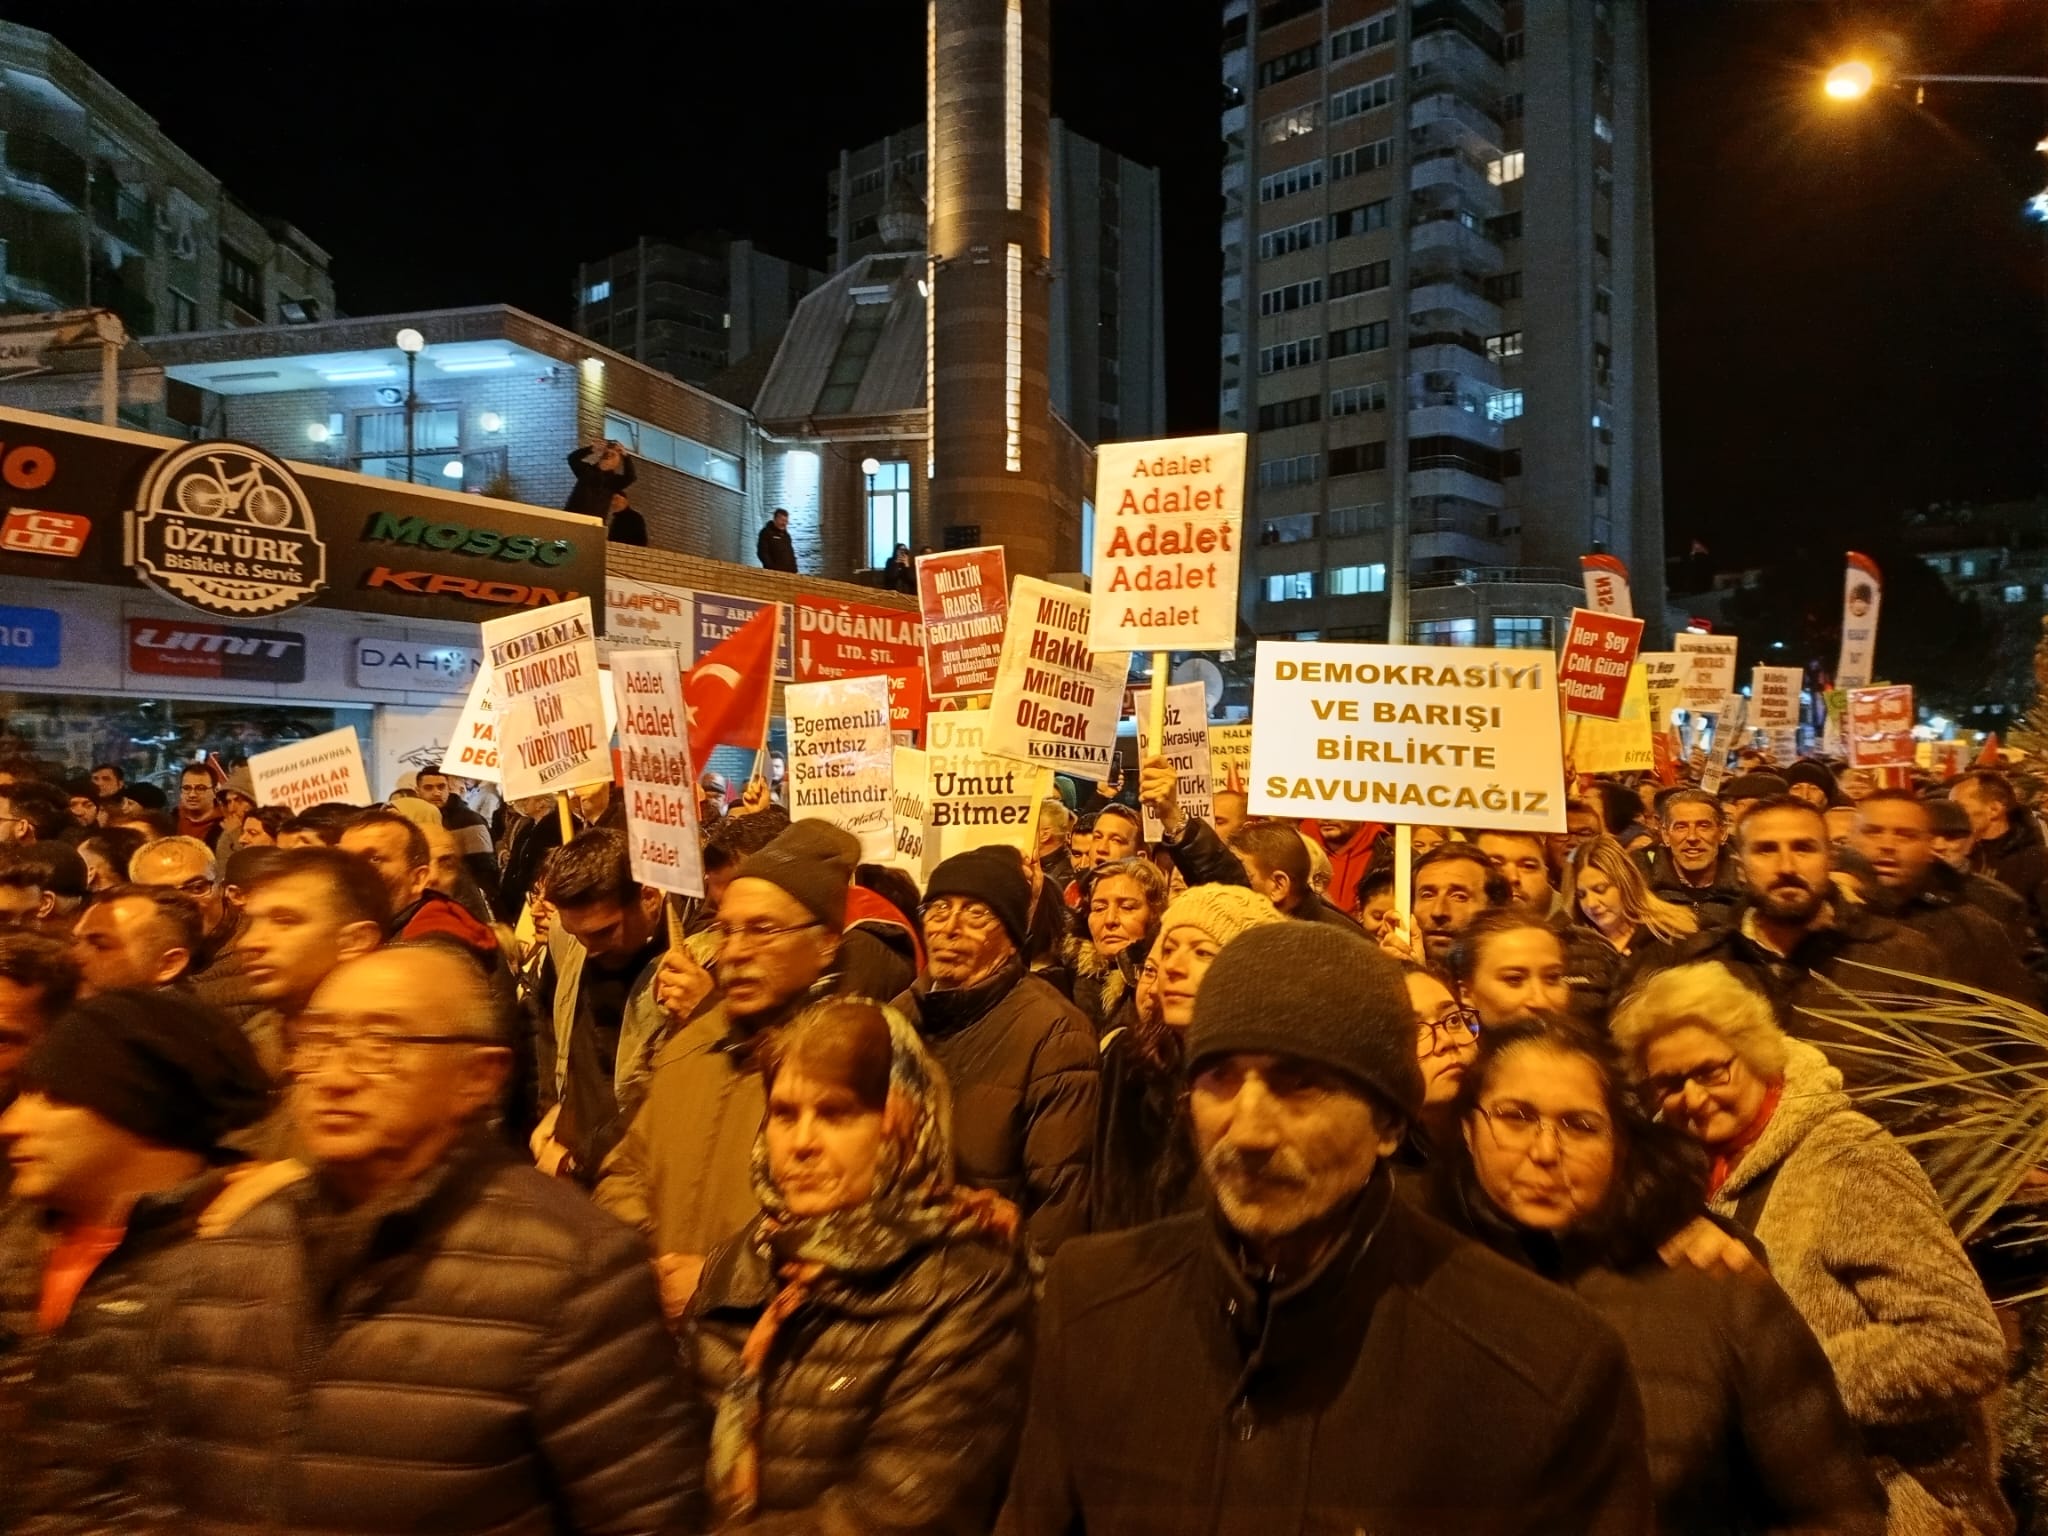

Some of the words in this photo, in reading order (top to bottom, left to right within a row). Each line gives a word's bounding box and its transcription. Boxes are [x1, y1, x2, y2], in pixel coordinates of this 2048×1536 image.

[1132, 455, 1212, 478] Adalet
[1117, 483, 1224, 516] Adalet
[164, 518, 303, 566] ÖZTÜRK
[368, 511, 578, 568] MOSSO
[1106, 519, 1233, 558] Adalet
[164, 553, 232, 575] Bisiklet
[233, 561, 250, 577] &
[251, 563, 303, 583] Servis
[934, 562, 983, 595] MİLLETİN
[1108, 562, 1217, 593] Adalet
[607, 590, 682, 616] UAFÖR
[941, 588, 983, 620] İRADESİ
[1036, 596, 1091, 636] Milleti
[1120, 606, 1200, 628] Adalet
[799, 603, 924, 648] DOĞANLAR
[929, 614, 1004, 646] GÖZALTINDA!
[1572, 626, 1599, 647] Her
[1604, 631, 1629, 653] Şey
[491, 618, 586, 668] KORKMA
[837, 643, 867, 661] LTD.
[1029, 629, 1095, 673] Hakkı
[505, 645, 582, 697] DEMOKRASİ
[1275, 659, 1543, 690] DEMOKRASİYİ
[1567, 652, 1593, 673] Çok
[1594, 656, 1629, 678] Güzel
[626, 671, 665, 695] Adalet
[1022, 667, 1096, 708] Milletin
[1564, 678, 1606, 701] Olacak
[534, 691, 564, 728] İÇİN
[625, 704, 678, 738] Adalet
[793, 709, 887, 736] Egemenlik
[1016, 699, 1090, 742] Olacak
[1311, 699, 1359, 722] VE
[1373, 701, 1501, 733] BARIŞI
[299, 745, 352, 768] SARAYINSA
[461, 746, 500, 769] DEĞ
[517, 722, 597, 771] YÜRÜYORUZ
[794, 736, 867, 760] Kayıtsız
[1028, 742, 1109, 762] KORKMA
[1317, 734, 1496, 770] BİRLİKTE
[539, 750, 590, 783] KORKMA
[628, 746, 689, 788] Adalet
[795, 762, 857, 784] Şartsız
[270, 766, 349, 800] SOKAKLAR
[280, 783, 349, 810] İZİMDİR!
[796, 785, 892, 807] Milletindir.
[933, 770, 1014, 797] Umut
[1176, 775, 1206, 795] Türk
[1266, 775, 1549, 817] SAVUNACAĞIZ
[633, 790, 686, 828] Adalet
[931, 801, 1031, 827] Bitmez
[640, 838, 681, 868] Adalet
